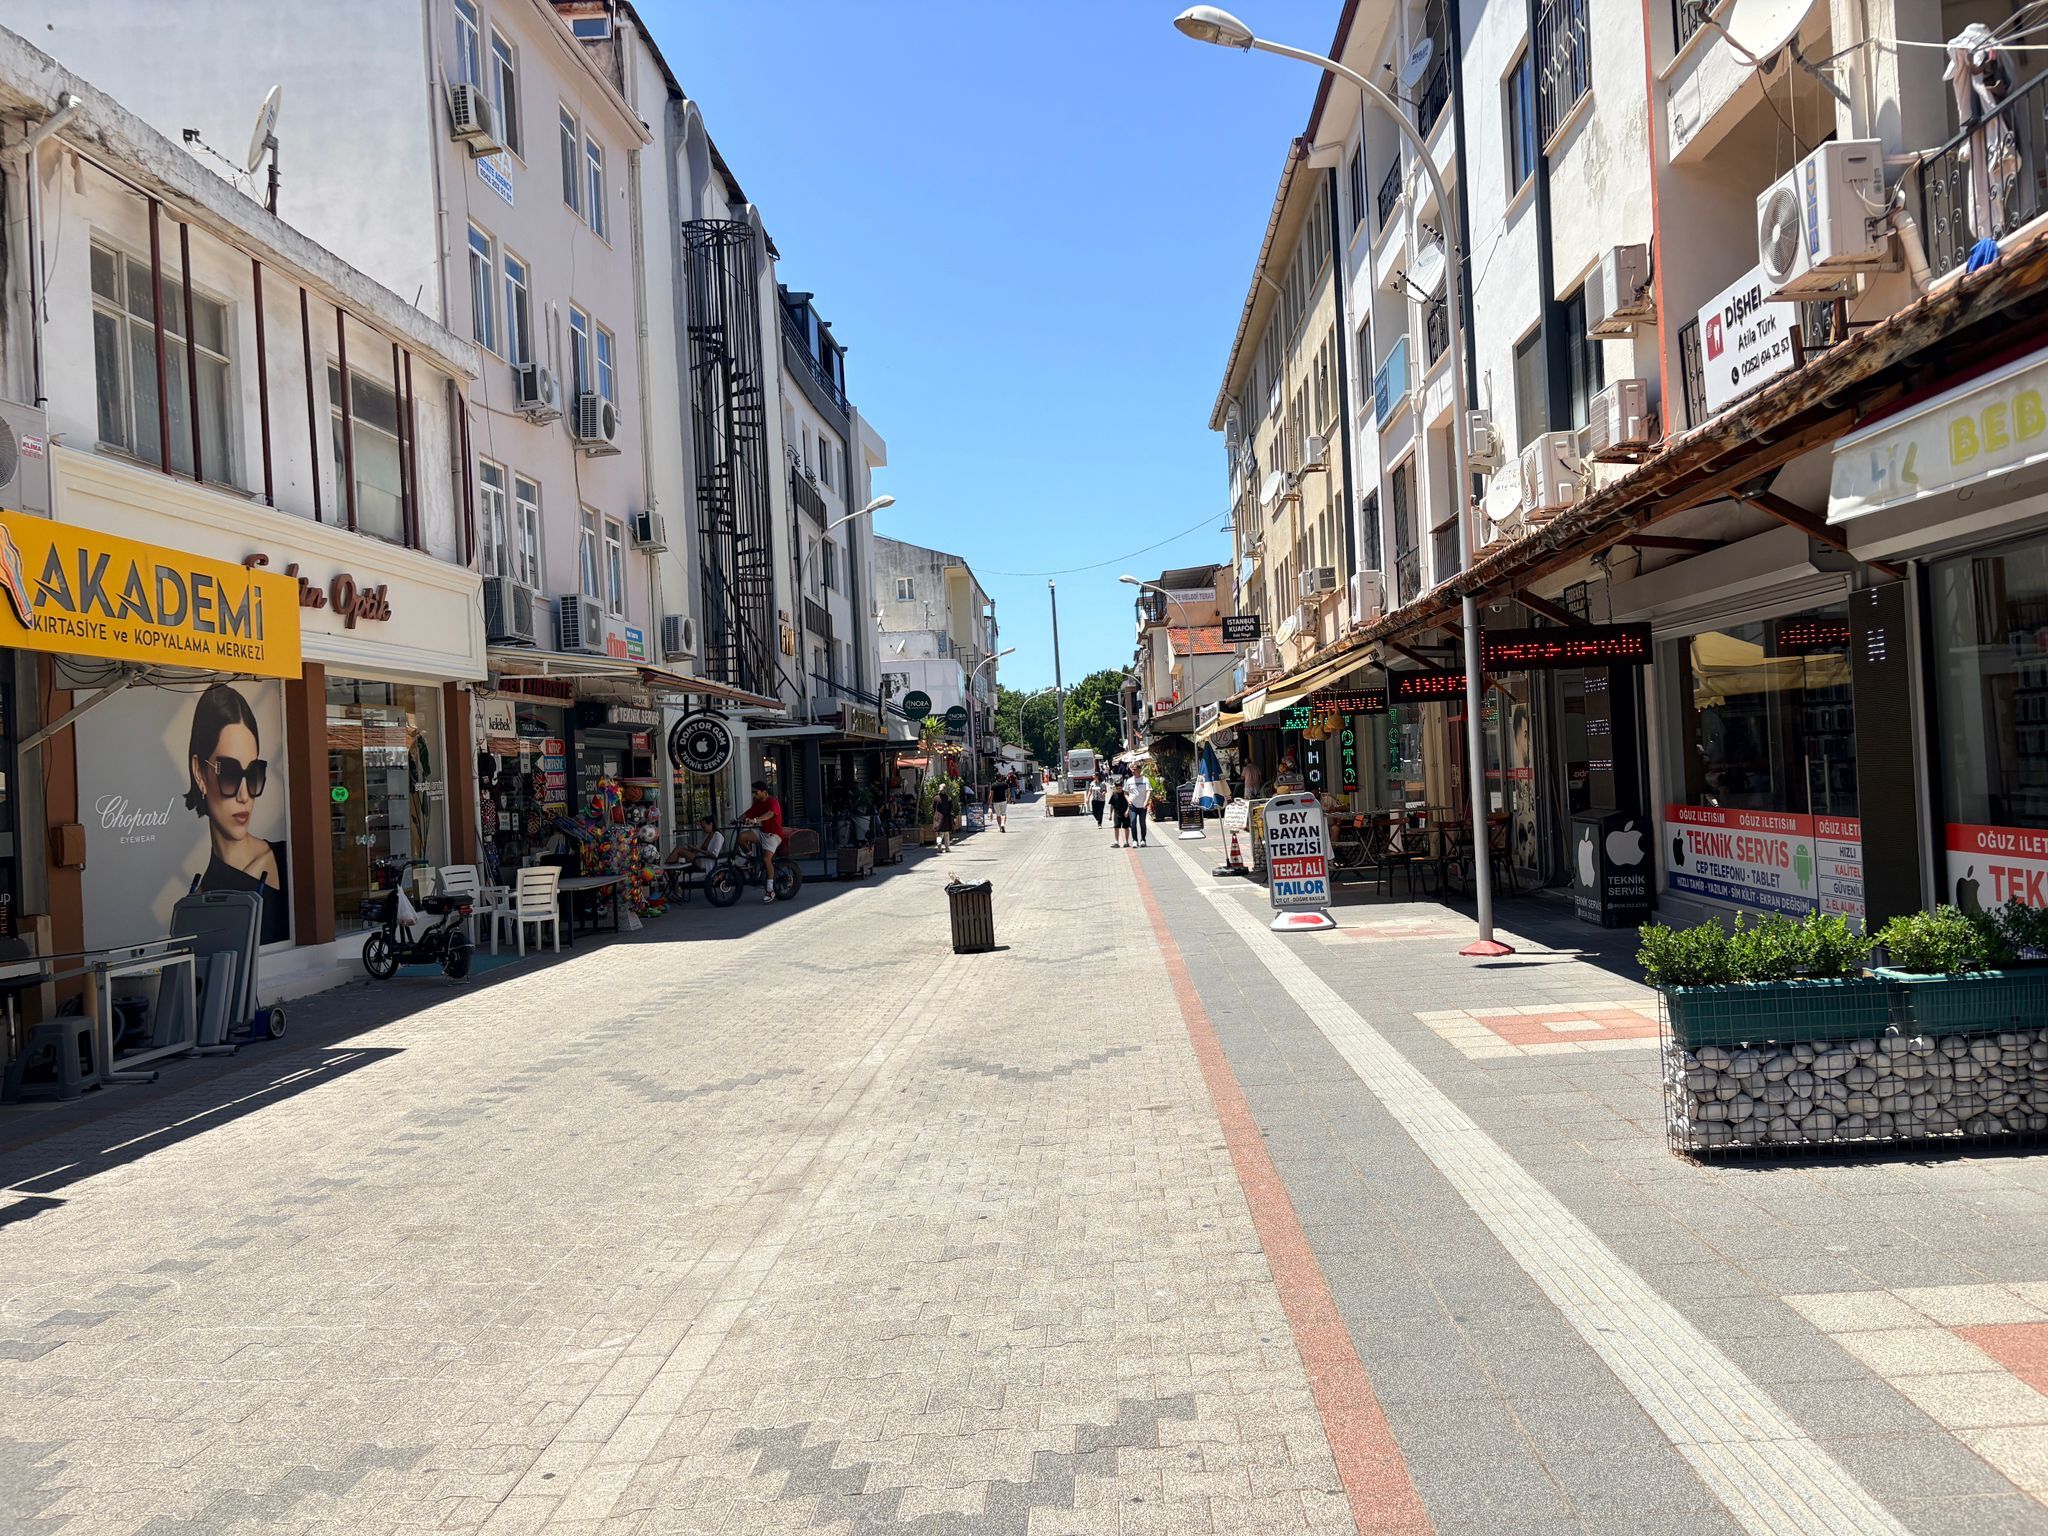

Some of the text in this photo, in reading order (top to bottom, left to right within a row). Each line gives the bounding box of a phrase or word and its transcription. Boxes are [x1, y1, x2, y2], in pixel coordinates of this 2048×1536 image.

[1738, 328, 1757, 352] Atila
[1757, 314, 1776, 338] Türk
[33, 542, 264, 641] AKADEMİ
[331, 573, 392, 630] Optik
[33, 614, 265, 661] KIRTASİYE ve KOPYALAMA MERKEZİ
[680, 722, 727, 746] DOKTOR GSM
[681, 751, 726, 770] TEKNİK SERVİS
[96, 795, 174, 834] Chopard
[1279, 811, 1308, 825] BAY
[1679, 808, 1697, 821] OĞUZ
[1739, 813, 1761, 826] OĞUZ
[1270, 825, 1320, 840] BAYAN
[1819, 819, 1841, 835] OĞUZ
[120, 835, 156, 844] EYEWEAR
[1270, 838, 1322, 857] TERZİSİ
[1978, 830, 2016, 850] OĞUZ
[1686, 830, 1790, 869] TEKNİK SERVİS
[1840, 847, 1857, 858] HIZLI
[1273, 859, 1323, 877] TERZİ ALİ
[1696, 860, 1780, 888] CEP TELEFONU TABLET
[1275, 880, 1324, 896] TAILOR
[1608, 873, 1646, 885] TEKNİK
[1608, 885, 1645, 896] SERVİS
